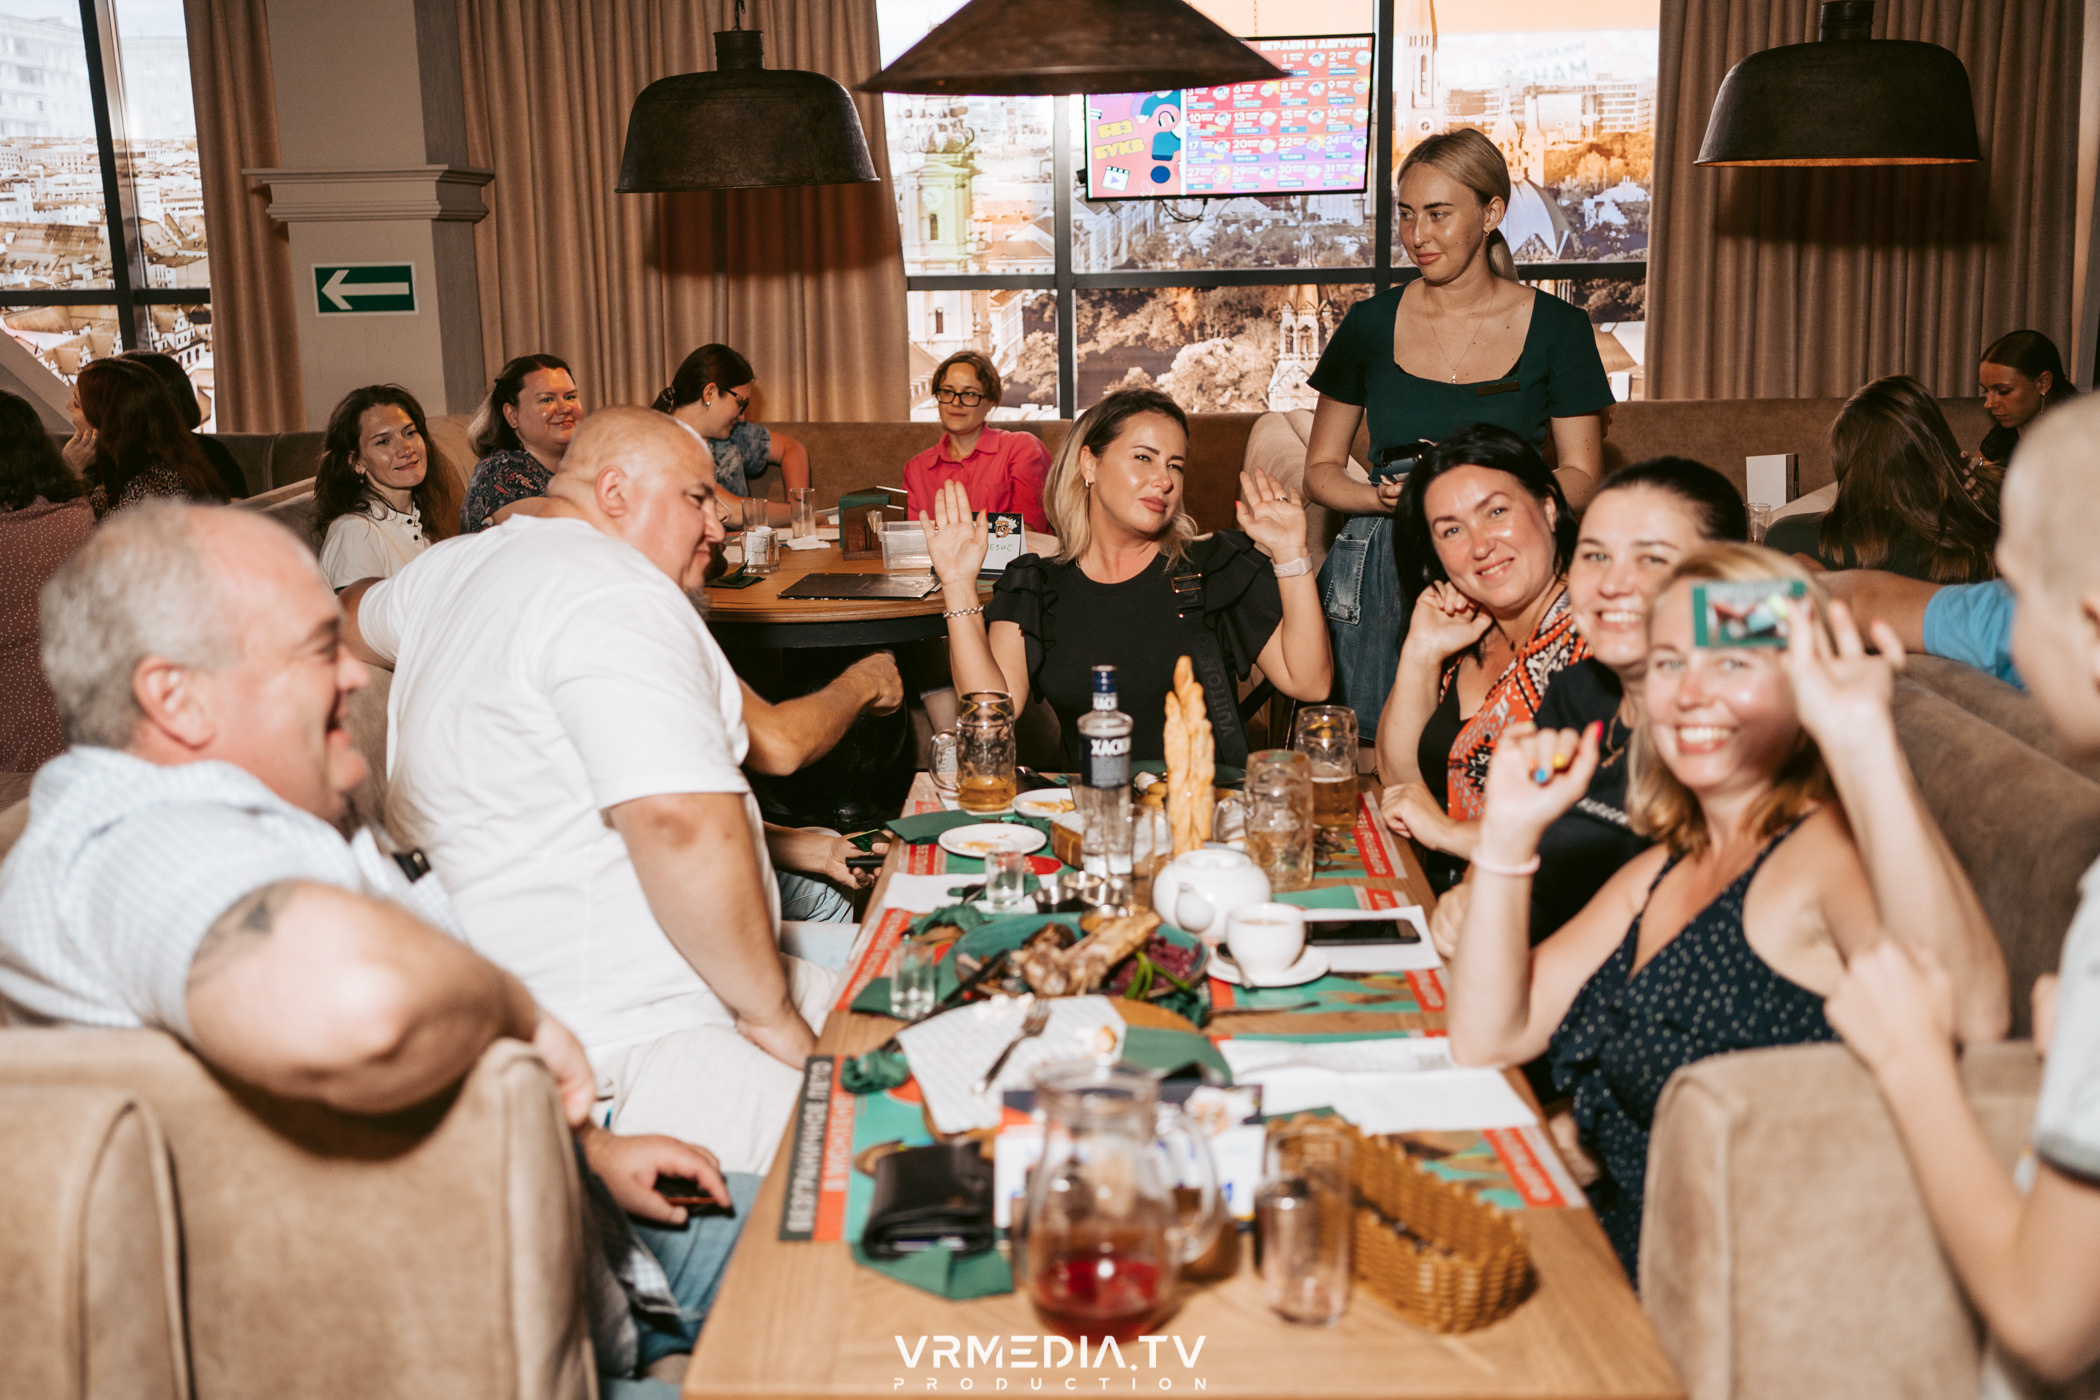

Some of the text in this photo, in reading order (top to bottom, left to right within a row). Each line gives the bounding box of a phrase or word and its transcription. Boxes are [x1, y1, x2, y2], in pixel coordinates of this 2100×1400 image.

[1307, 39, 1316, 50] В
[1317, 38, 1369, 49] АВГУСТЕ
[1097, 119, 1134, 139] БЕЗ
[1093, 138, 1146, 160] БУКВ
[988, 543, 1013, 552] ЕЗИС
